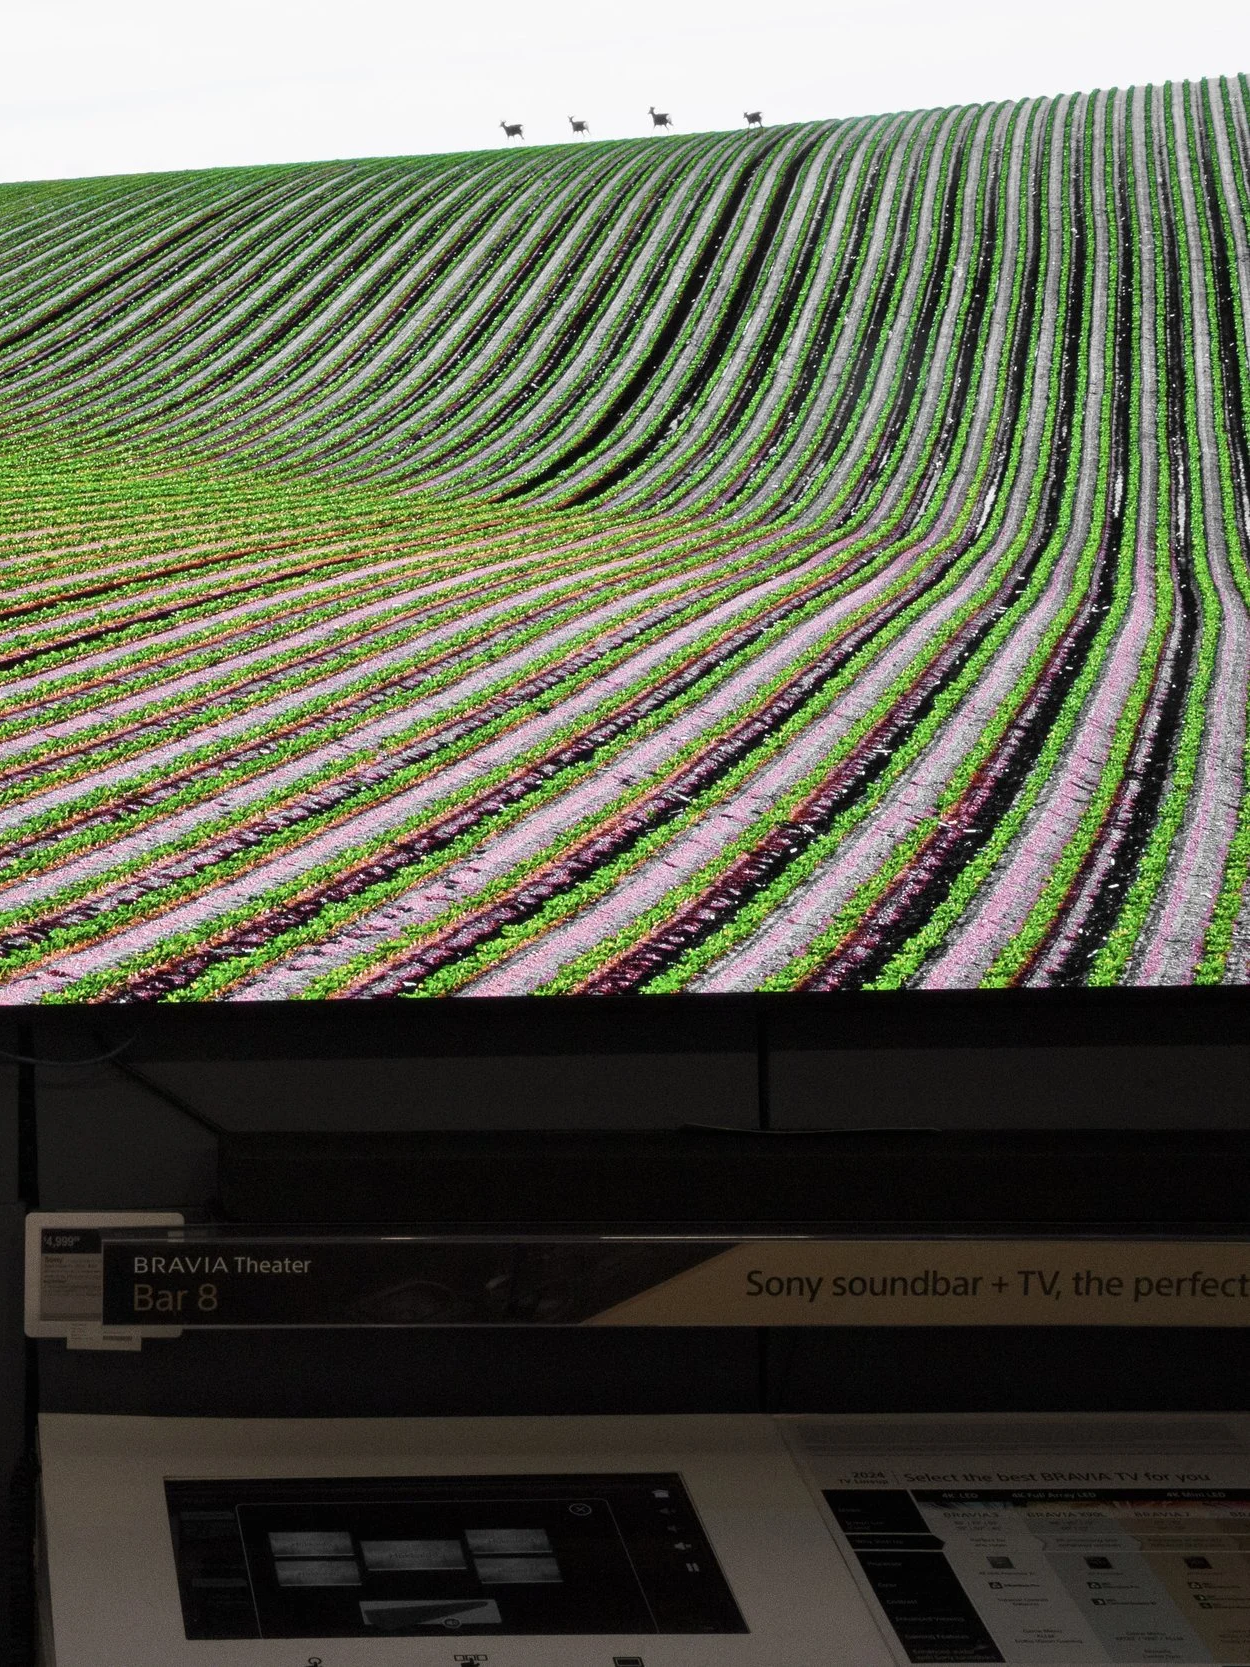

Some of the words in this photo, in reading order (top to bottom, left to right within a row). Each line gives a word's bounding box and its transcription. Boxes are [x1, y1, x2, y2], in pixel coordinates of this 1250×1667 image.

[134, 1256, 229, 1274] BRAVIA
[234, 1256, 312, 1274] Theater
[133, 1283, 188, 1312] Bar
[197, 1283, 218, 1312] 8
[746, 1270, 823, 1302] Sony
[832, 1270, 983, 1296] soundbar
[1017, 1270, 1061, 1300] TV,
[1072, 1270, 1124, 1296] the
[1134, 1270, 1250, 1302] perfect
[904, 1473, 958, 1482] Select
[962, 1473, 992, 1482] the
[996, 1473, 1038, 1482] best
[1041, 1472, 1112, 1482] BRAVIA
[1114, 1472, 1139, 1482] TV
[1145, 1472, 1170, 1482] for
[1175, 1474, 1211, 1483] you
